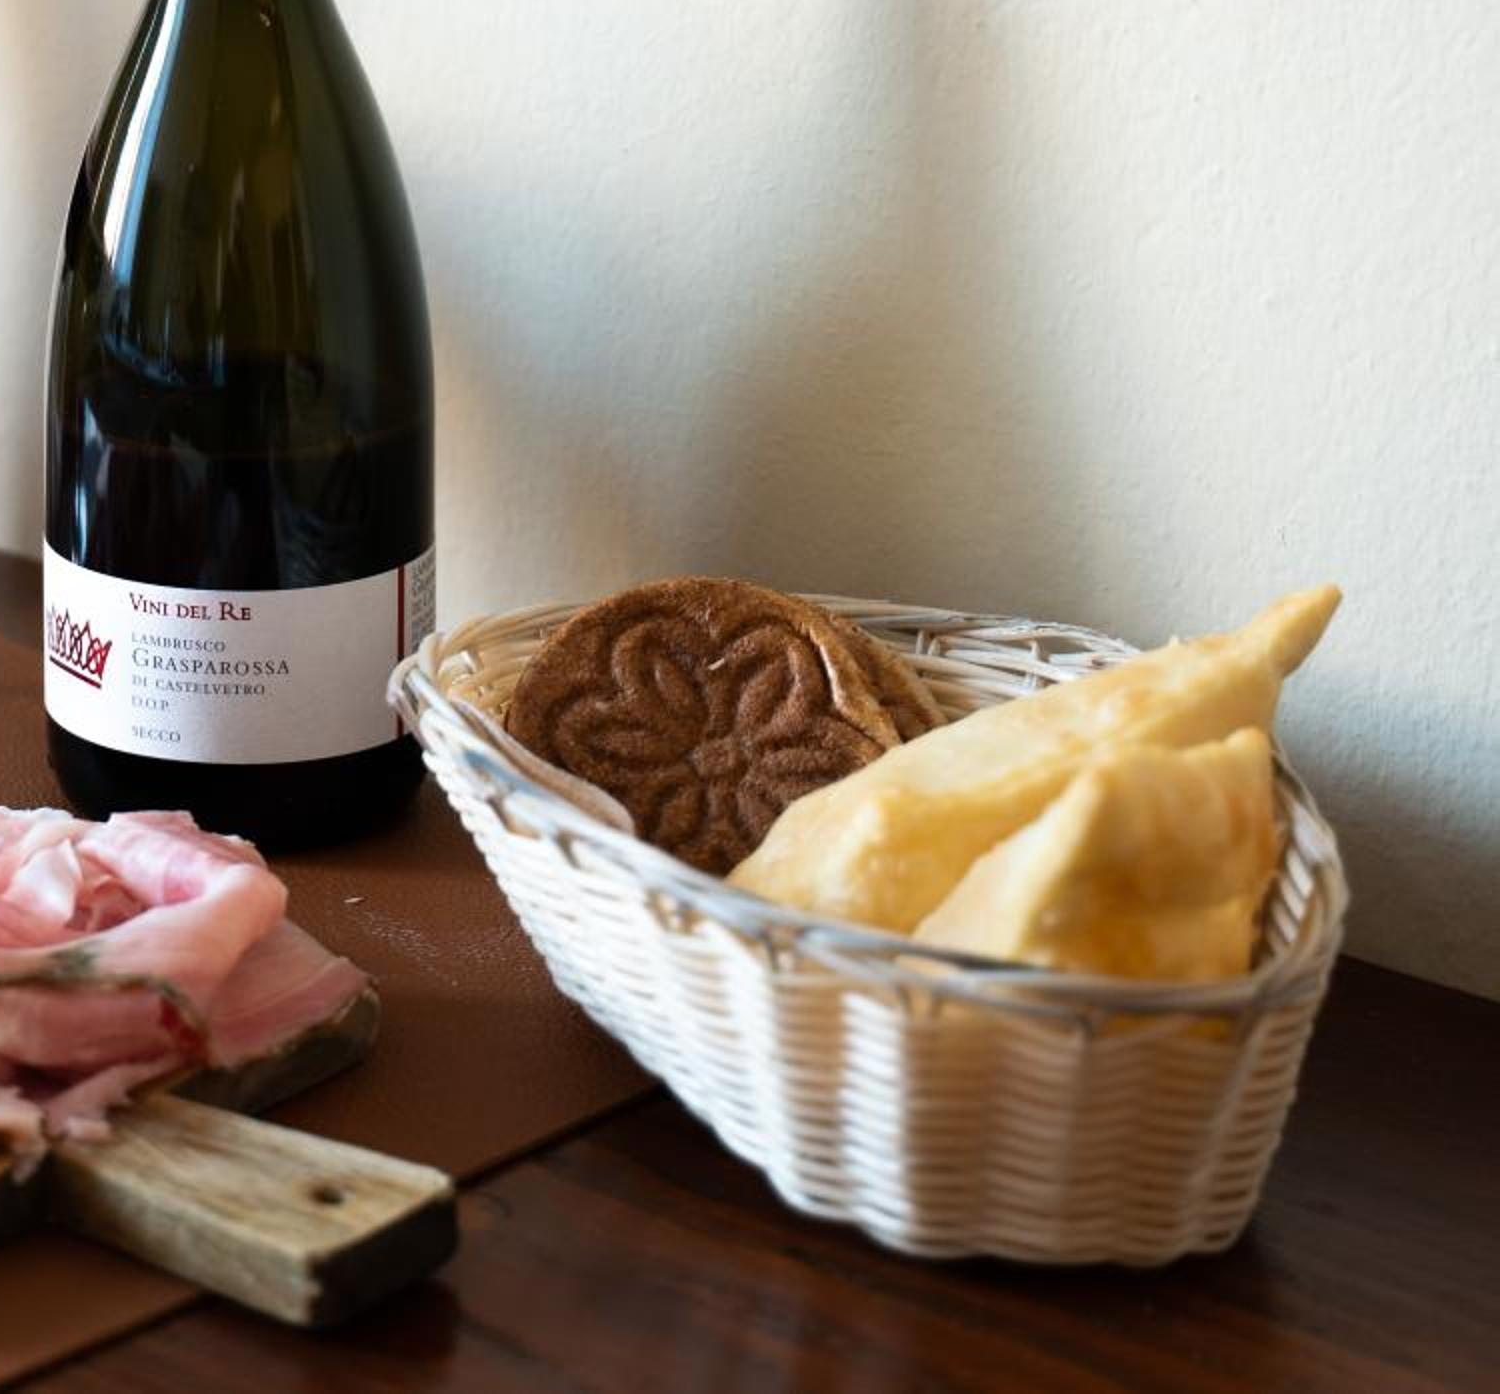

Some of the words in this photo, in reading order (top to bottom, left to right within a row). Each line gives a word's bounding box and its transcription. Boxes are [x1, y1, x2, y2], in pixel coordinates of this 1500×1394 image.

[129, 592, 169, 616] VINI
[176, 604, 211, 621] DEL
[219, 601, 251, 621] RE
[132, 632, 226, 653] LAMBRUSCO
[132, 648, 289, 676] GRASPAROSSA
[132, 675, 148, 687] DI
[156, 678, 266, 696] CASTELVETRO
[132, 725, 182, 744] SECCO
